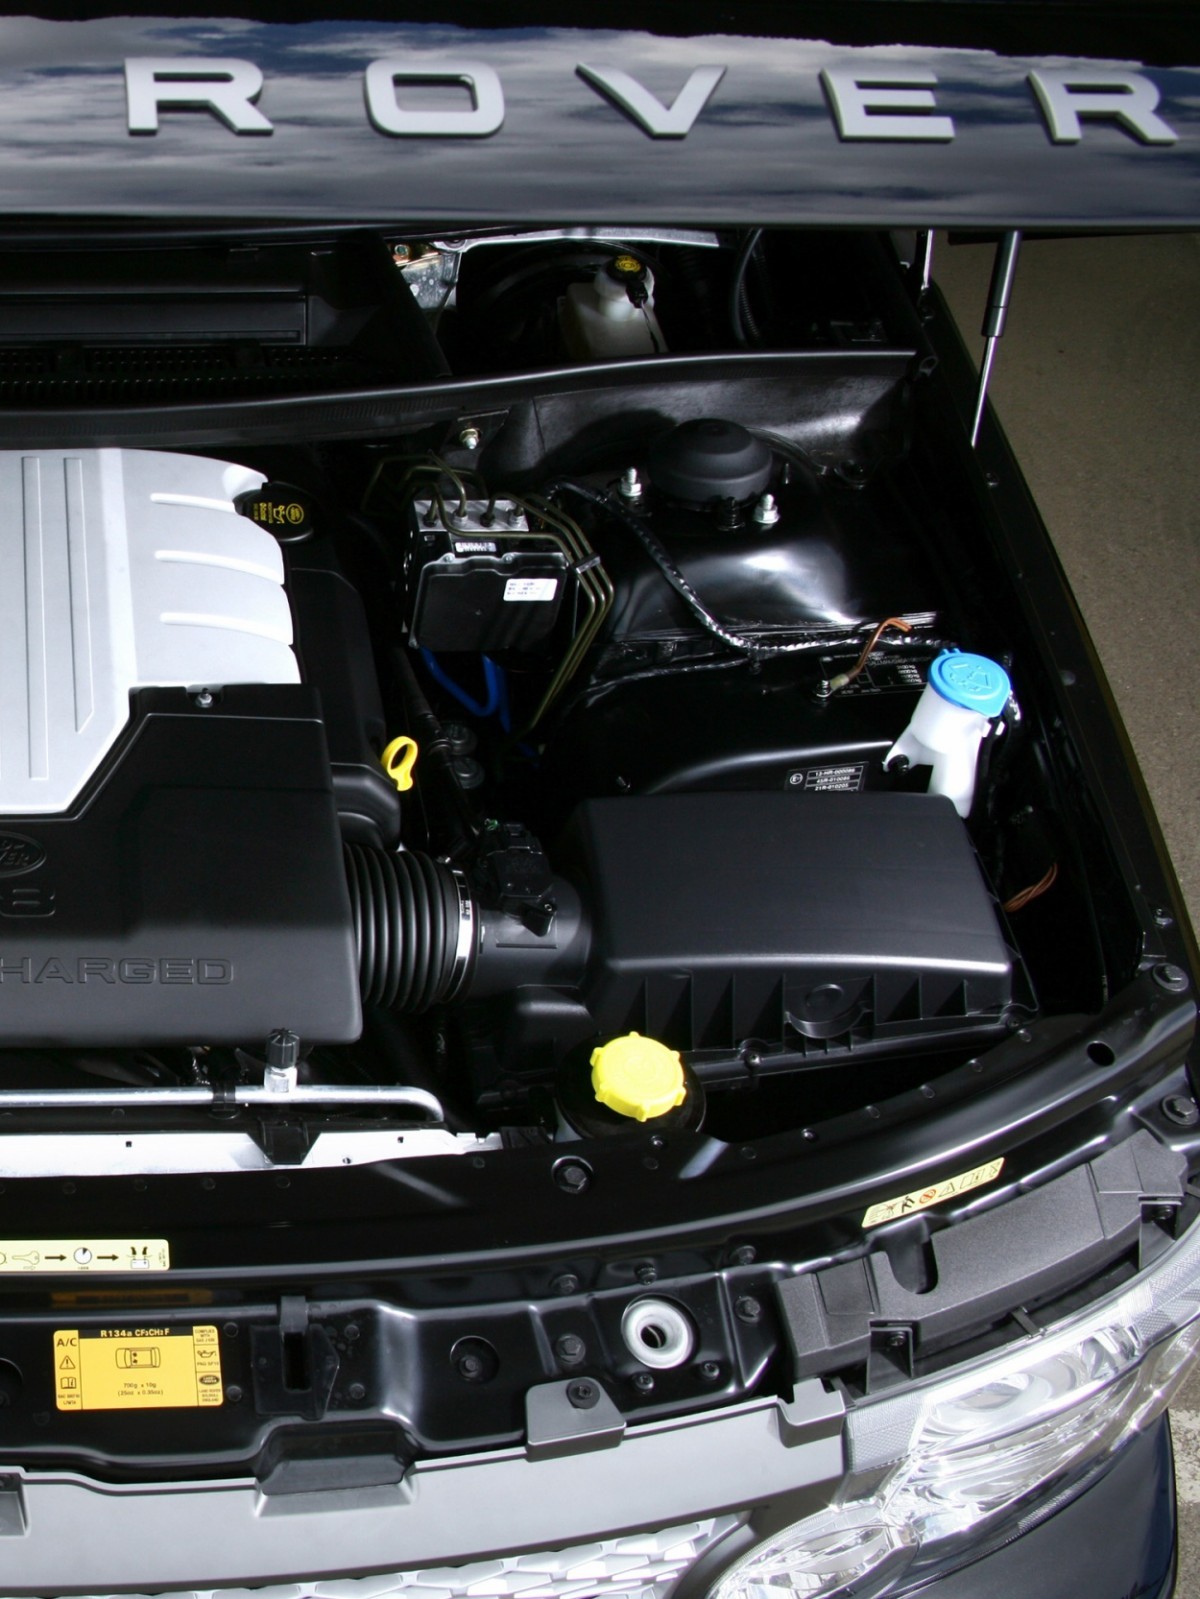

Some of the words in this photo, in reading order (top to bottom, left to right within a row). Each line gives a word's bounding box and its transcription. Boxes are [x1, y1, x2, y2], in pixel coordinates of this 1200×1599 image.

[123, 57, 1179, 146] ROVER
[100, 1329, 132, 1338] R134a
[56, 1338, 77, 1347] A/C
